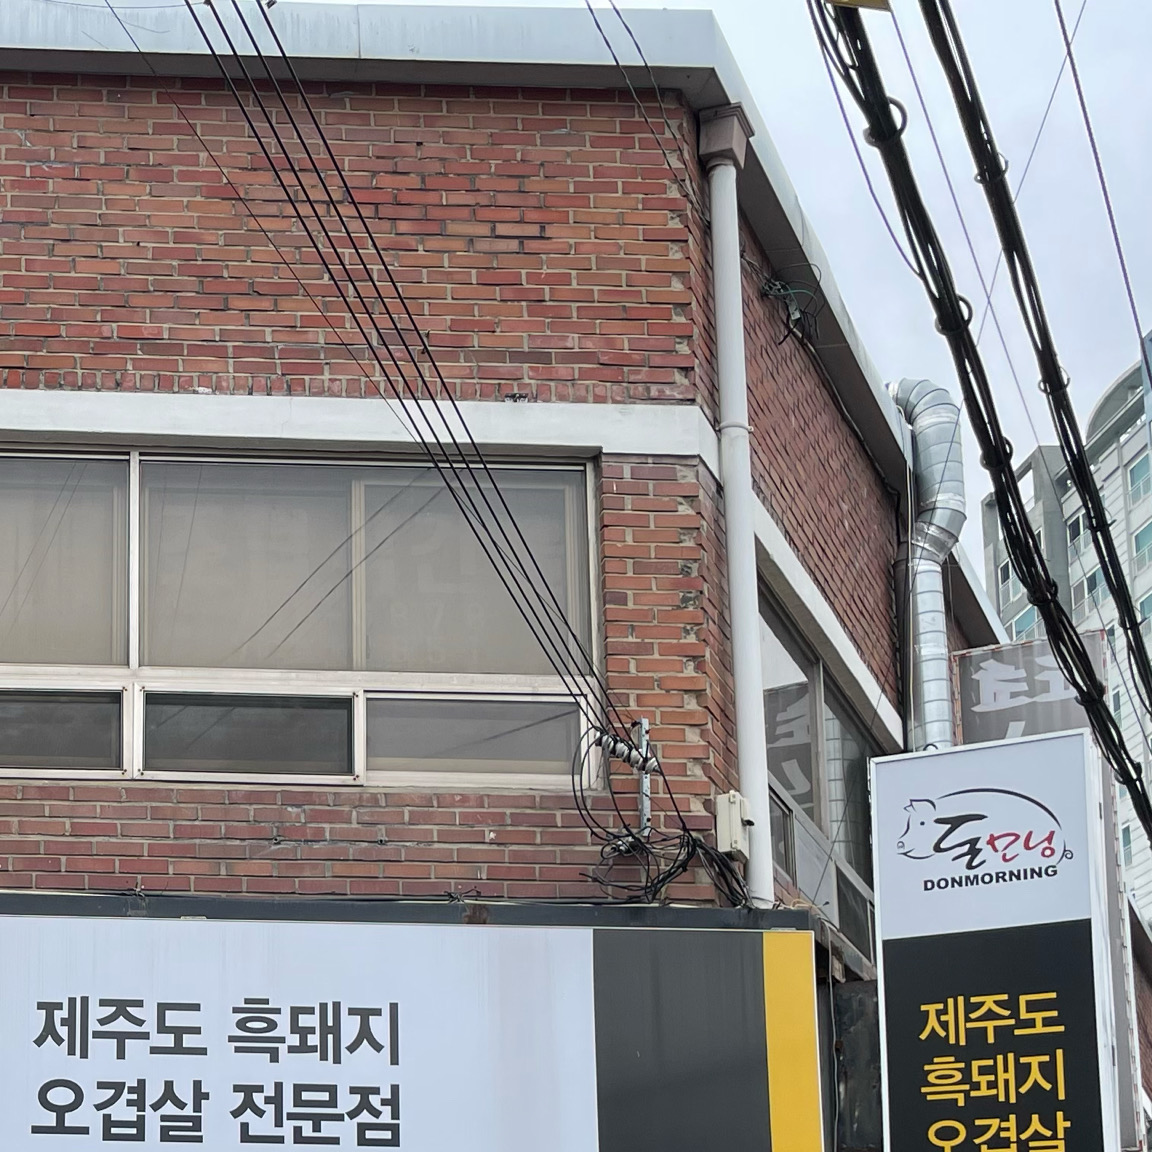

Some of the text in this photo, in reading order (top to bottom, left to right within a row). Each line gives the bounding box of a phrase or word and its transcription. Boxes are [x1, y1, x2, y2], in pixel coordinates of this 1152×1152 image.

[923, 865, 1058, 892] DONMORNING
[32, 996, 400, 1066] 제주도 흑돼지
[918, 990, 1065, 1045] 제주도
[921, 1051, 1066, 1106] 흑돼지
[30, 1078, 401, 1148] 오겹살 전문점
